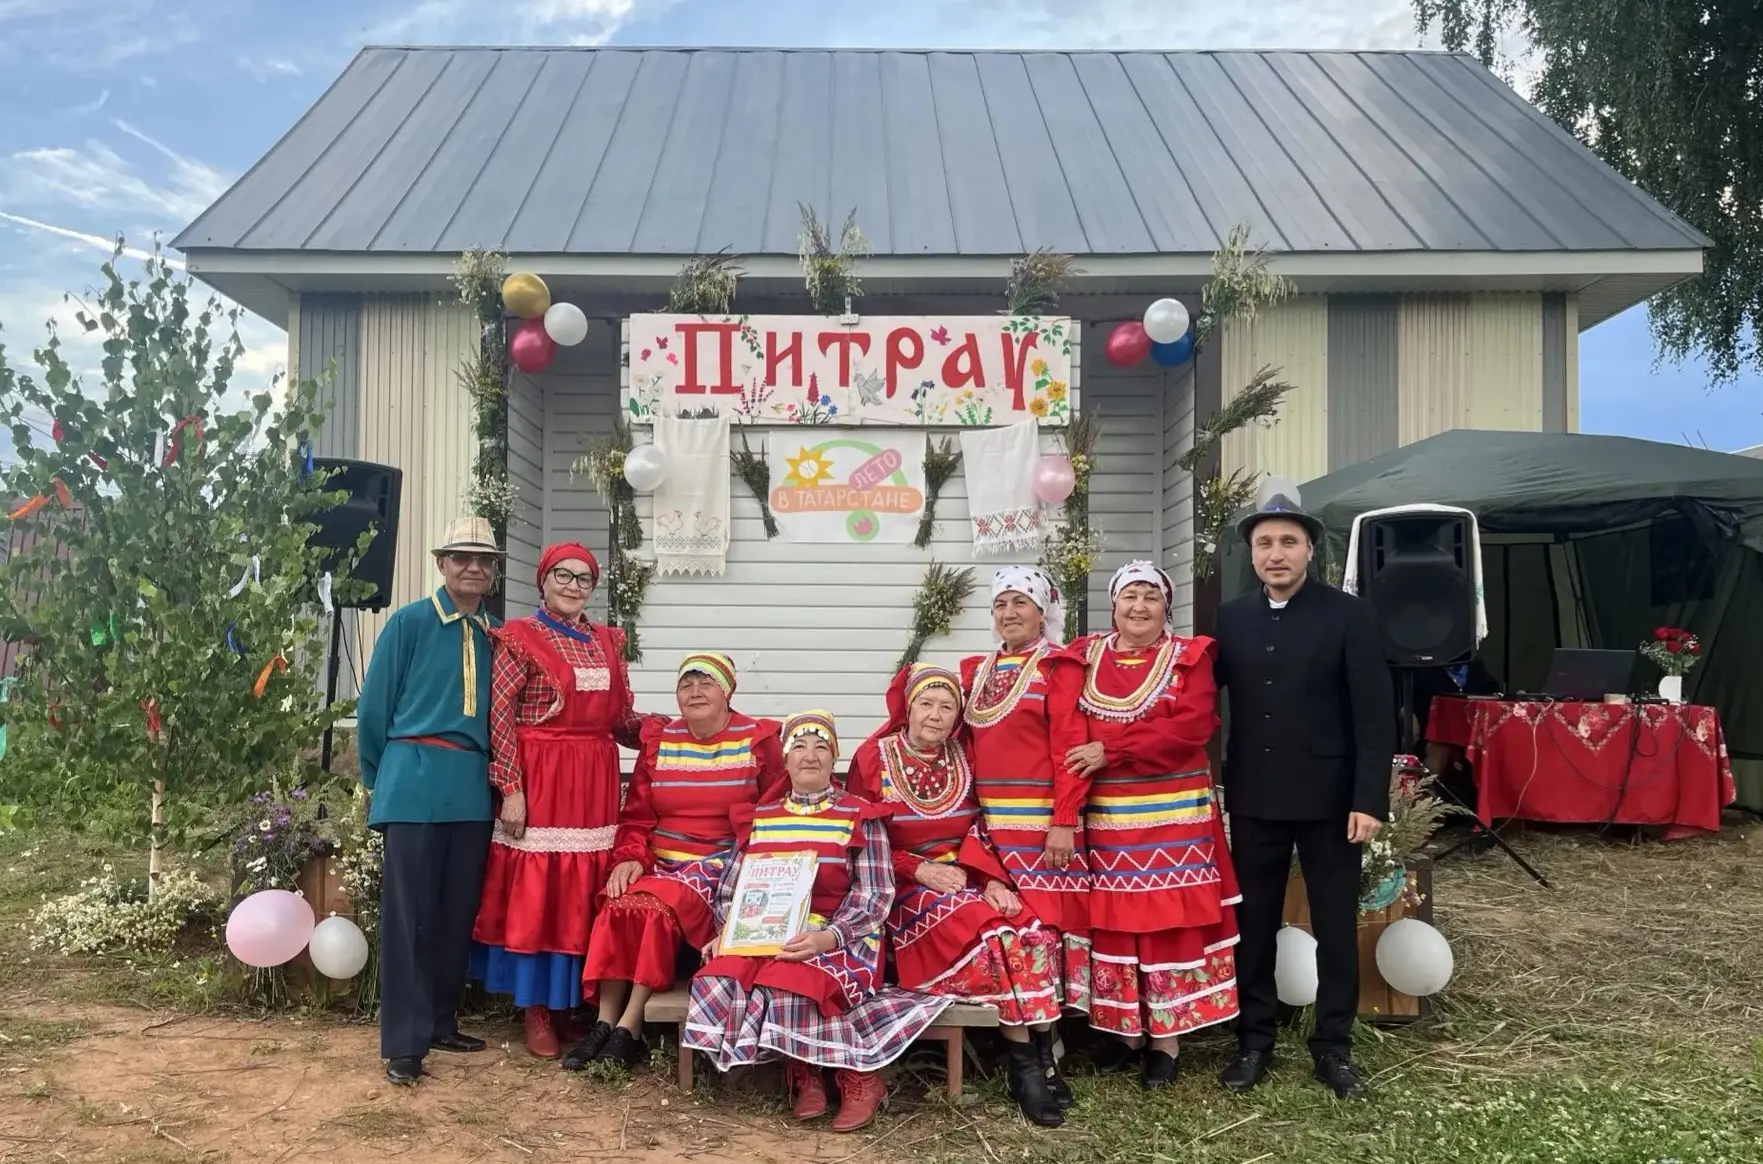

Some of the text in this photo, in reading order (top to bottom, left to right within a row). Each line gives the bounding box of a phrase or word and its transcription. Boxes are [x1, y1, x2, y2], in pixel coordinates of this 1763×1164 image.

[855, 450, 897, 490] ЛЕТО
[778, 489, 911, 509] В ТАТАРСТАНЕ
